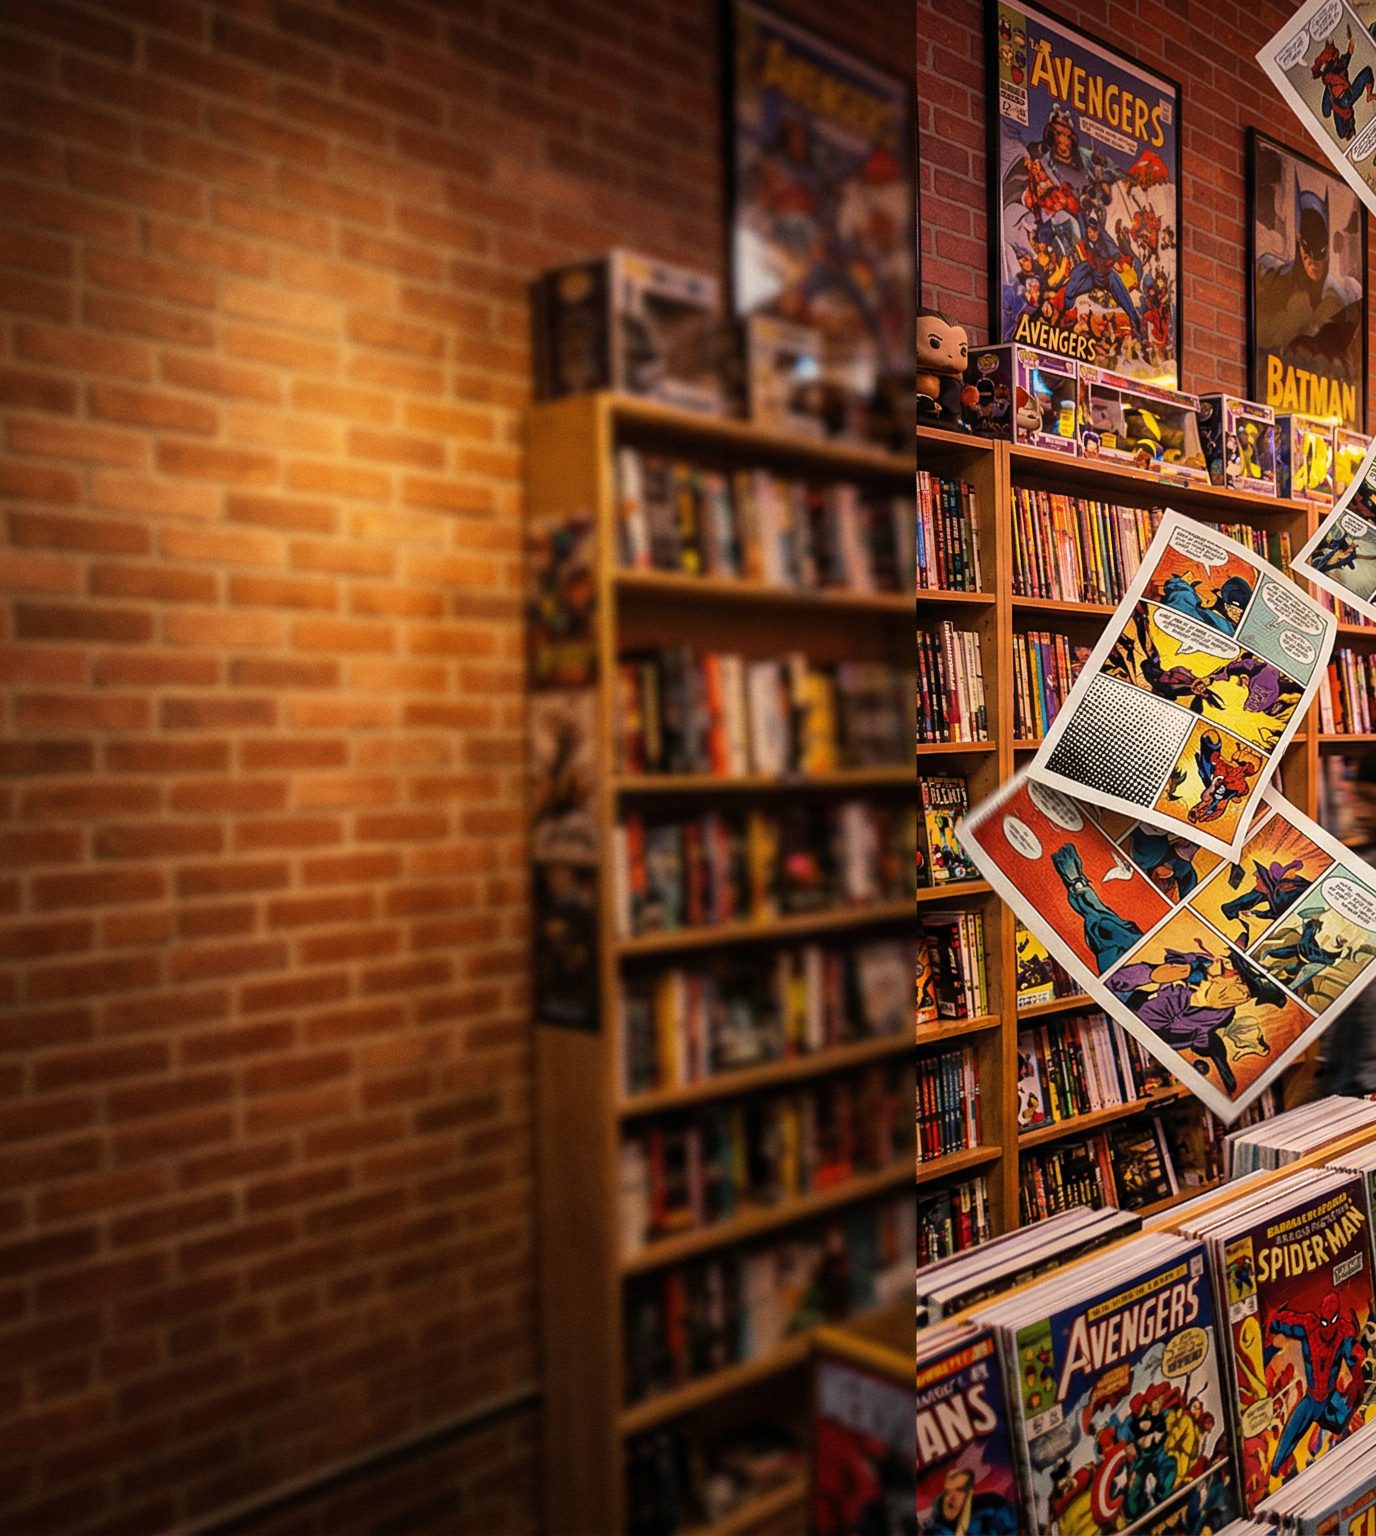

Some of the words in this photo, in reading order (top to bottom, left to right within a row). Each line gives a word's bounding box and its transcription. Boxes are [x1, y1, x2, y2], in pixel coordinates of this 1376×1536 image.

[1030, 39, 1164, 148] AVENGERS
[1014, 313, 1097, 362] AVENGERS
[1266, 353, 1357, 423] BATMAN
[1056, 1276, 1200, 1403] AVENGERS
